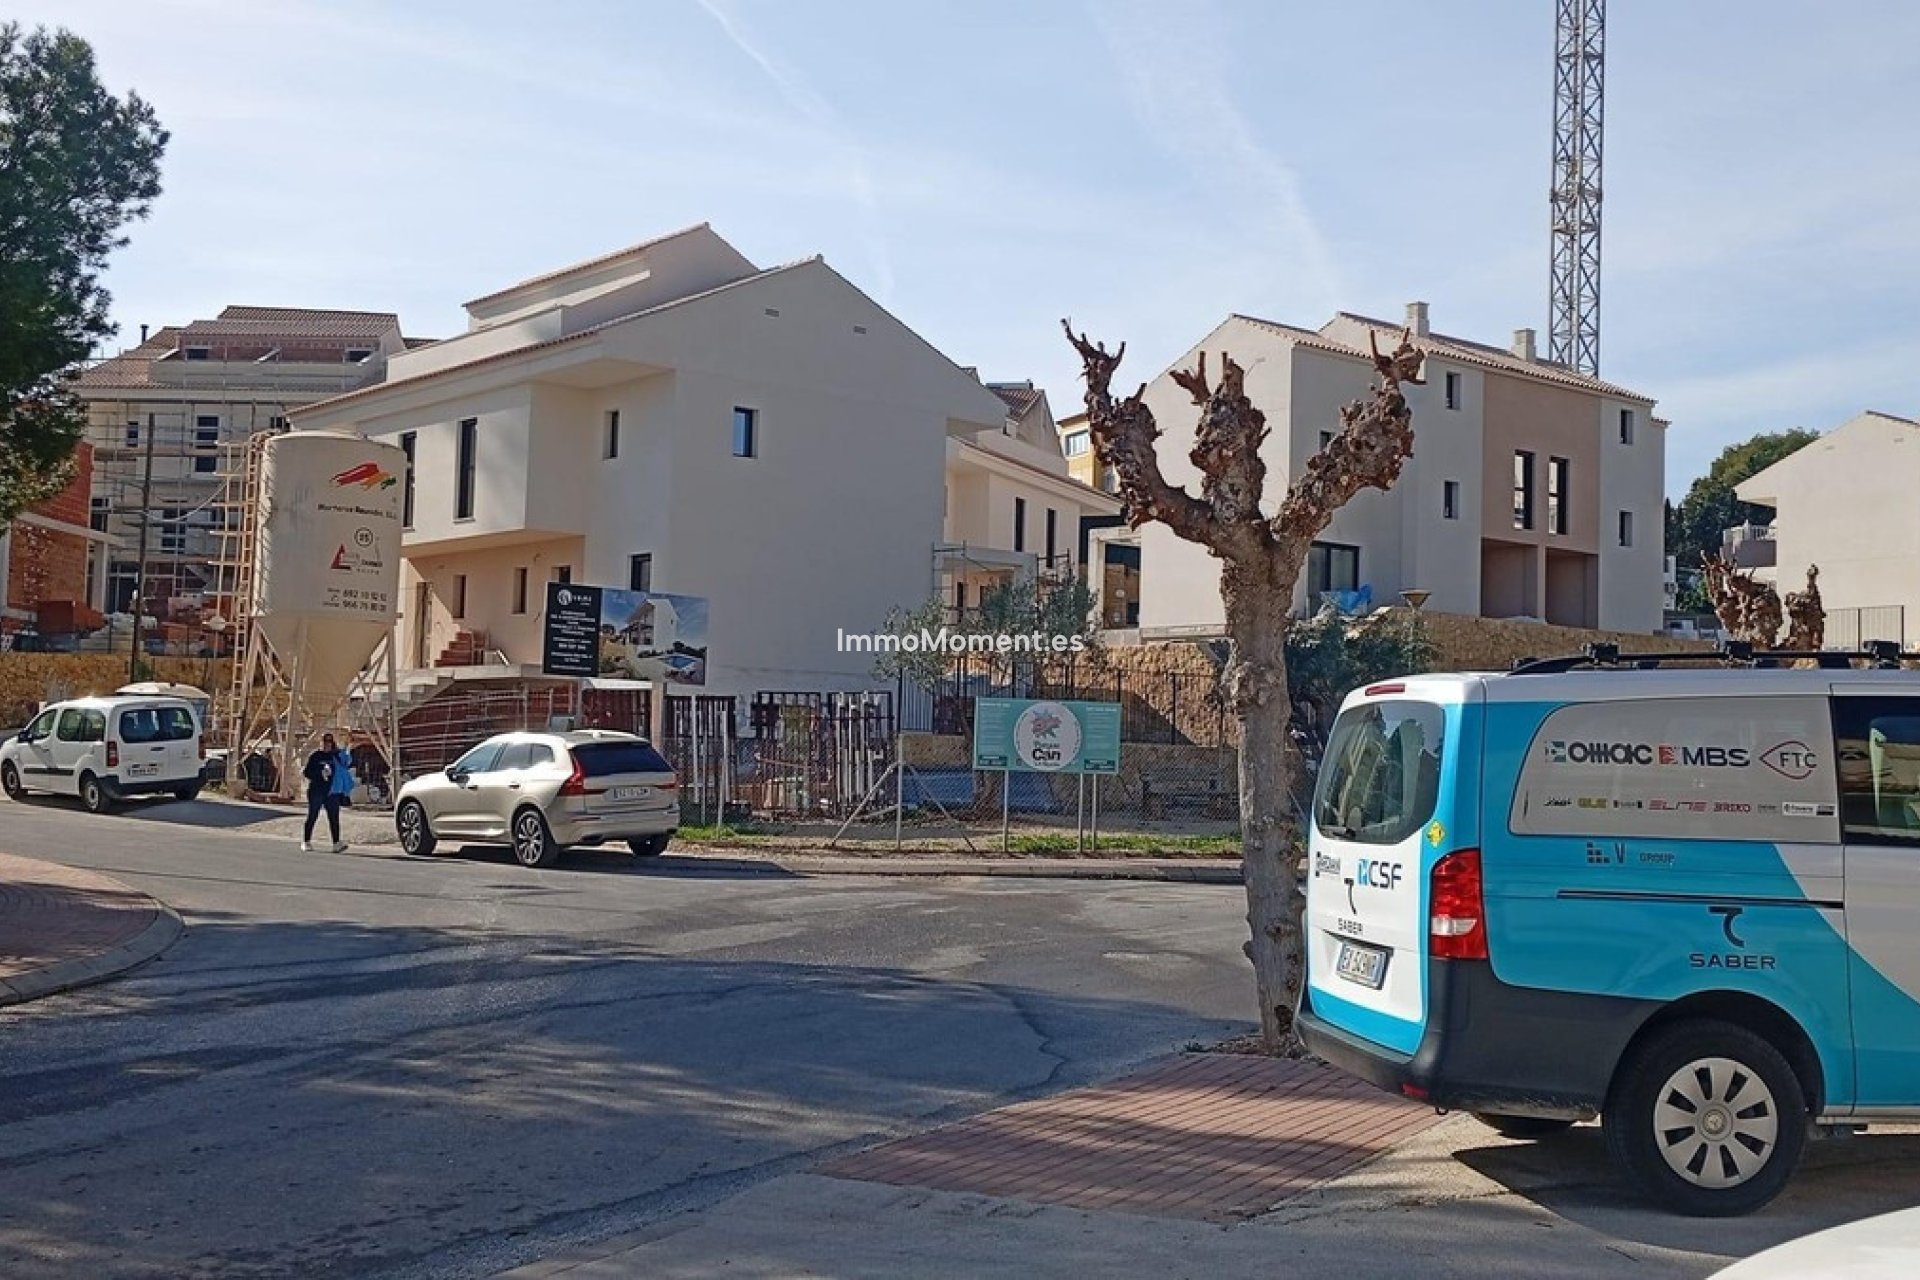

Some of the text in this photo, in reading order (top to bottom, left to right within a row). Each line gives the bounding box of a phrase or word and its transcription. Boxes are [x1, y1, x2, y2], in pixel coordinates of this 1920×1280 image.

[1033, 748, 1061, 761] Can
[1780, 752, 1817, 769] FTC
[1369, 860, 1403, 891] CSF
[1689, 953, 1776, 970] SABER
